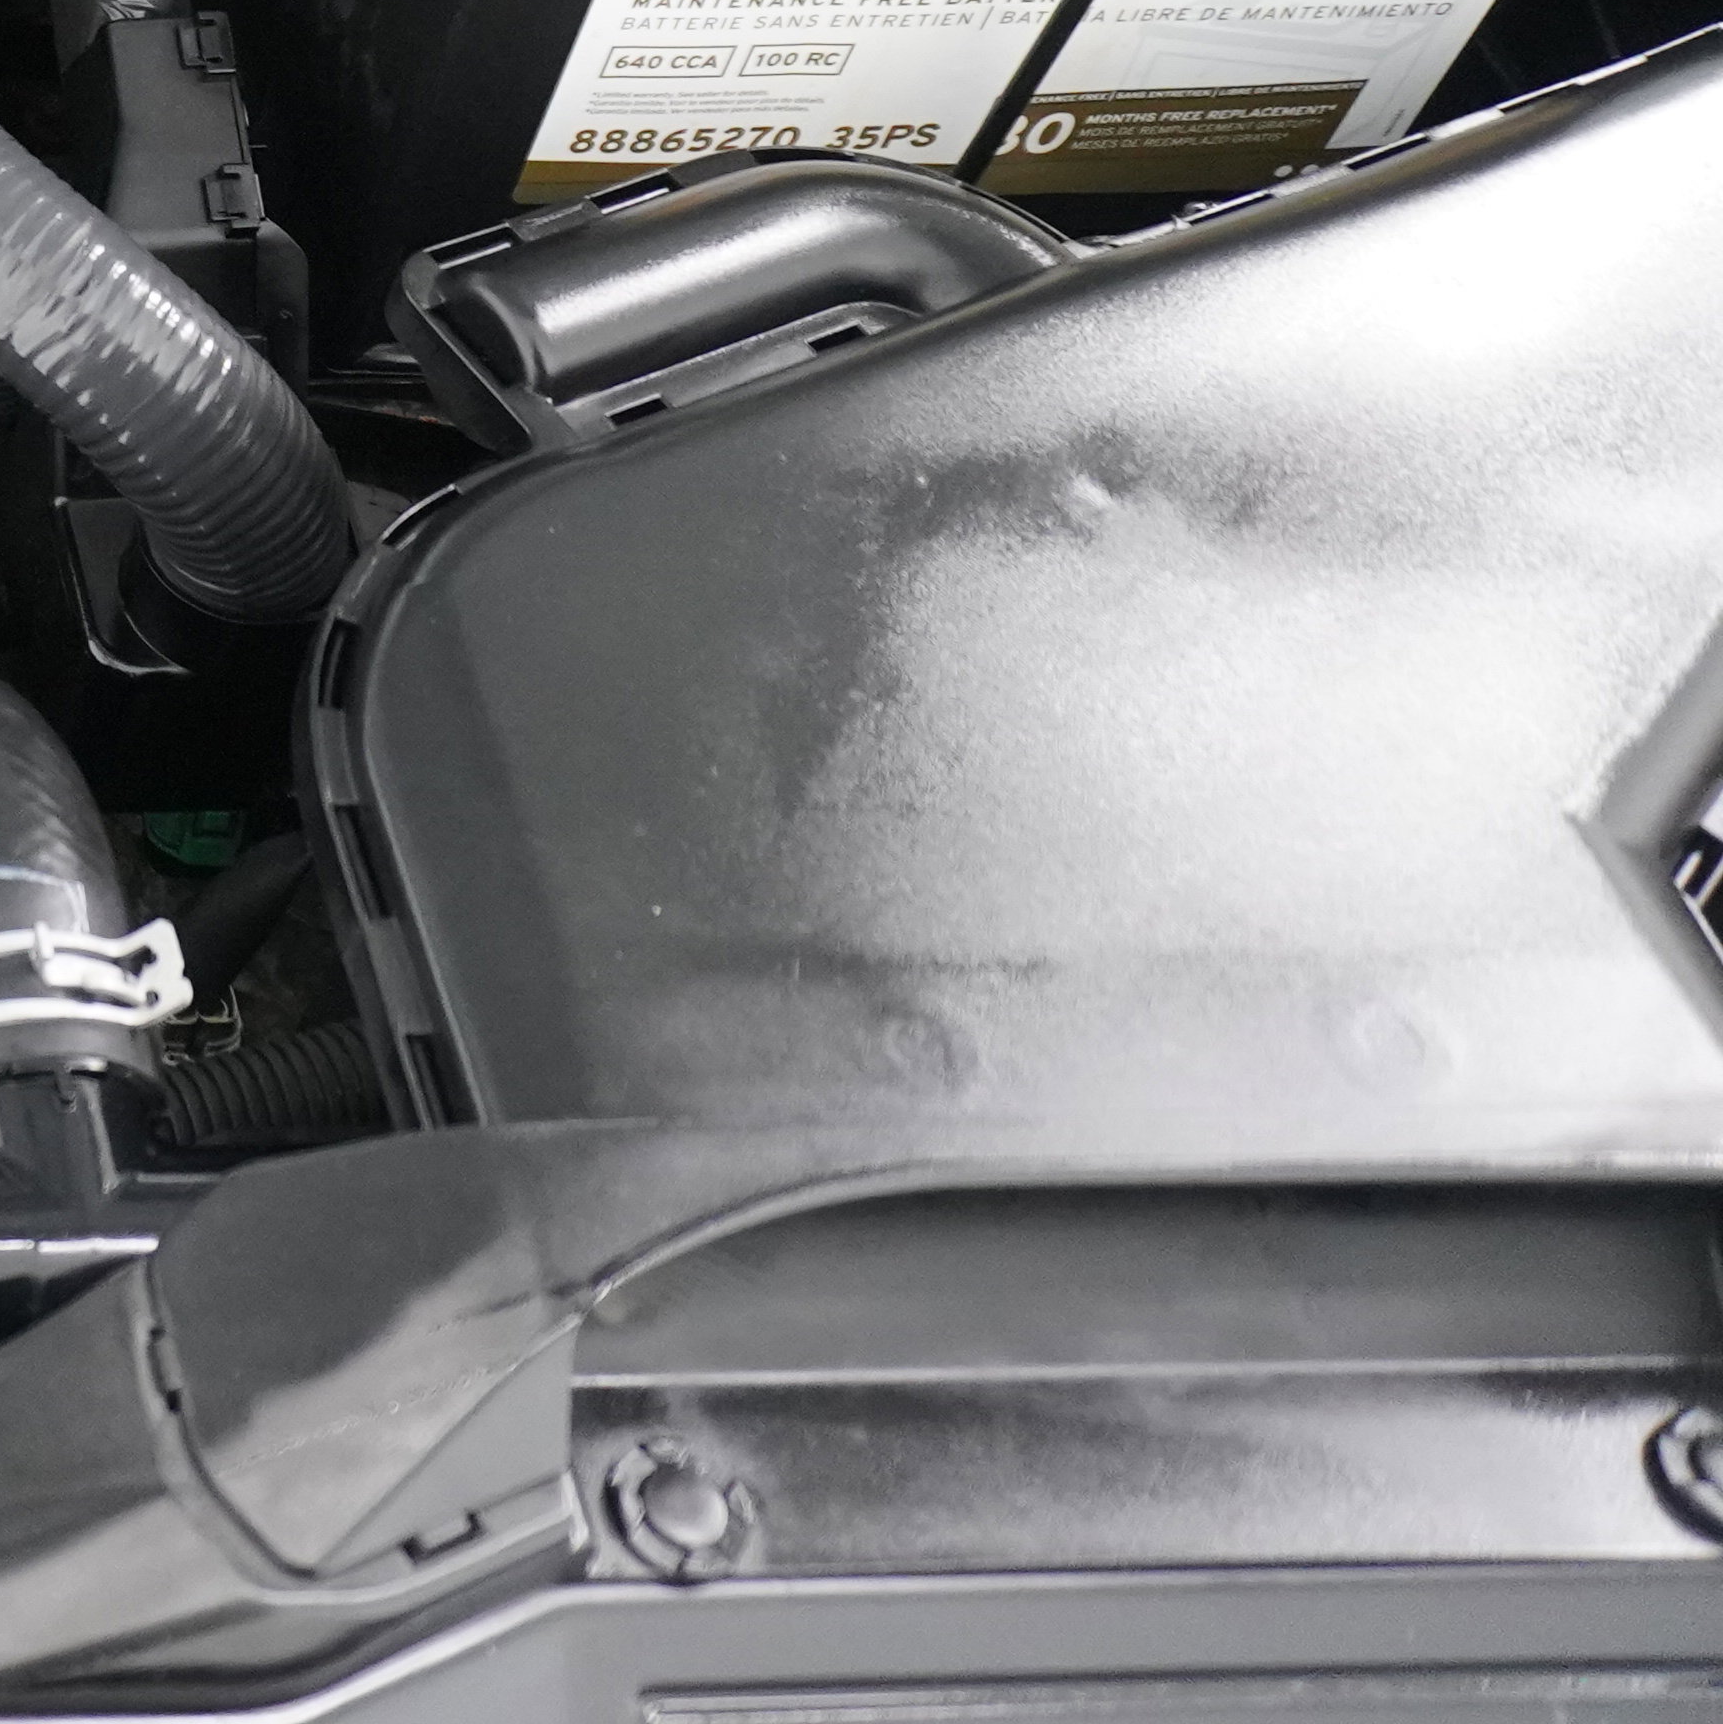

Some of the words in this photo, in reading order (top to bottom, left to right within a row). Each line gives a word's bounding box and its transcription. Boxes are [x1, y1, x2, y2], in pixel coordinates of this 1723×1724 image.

[619, 15, 745, 31] BATTERIE
[753, 14, 821, 29] SANS
[828, 10, 975, 28] ENTRETIEN
[1116, 8, 1192, 23] LIBRE
[1199, 7, 1235, 22] DE
[1241, 2, 1454, 21] MANTENIMIENTO
[614, 55, 663, 69] 640
[670, 55, 719, 69] CCA
[756, 52, 799, 67] 100
[804, 52, 841, 67] RC
[1085, 112, 1157, 125] MONTHS
[1159, 110, 1203, 122] FREE
[570, 125, 801, 154] 88865270
[825, 123, 941, 150] 35PS
